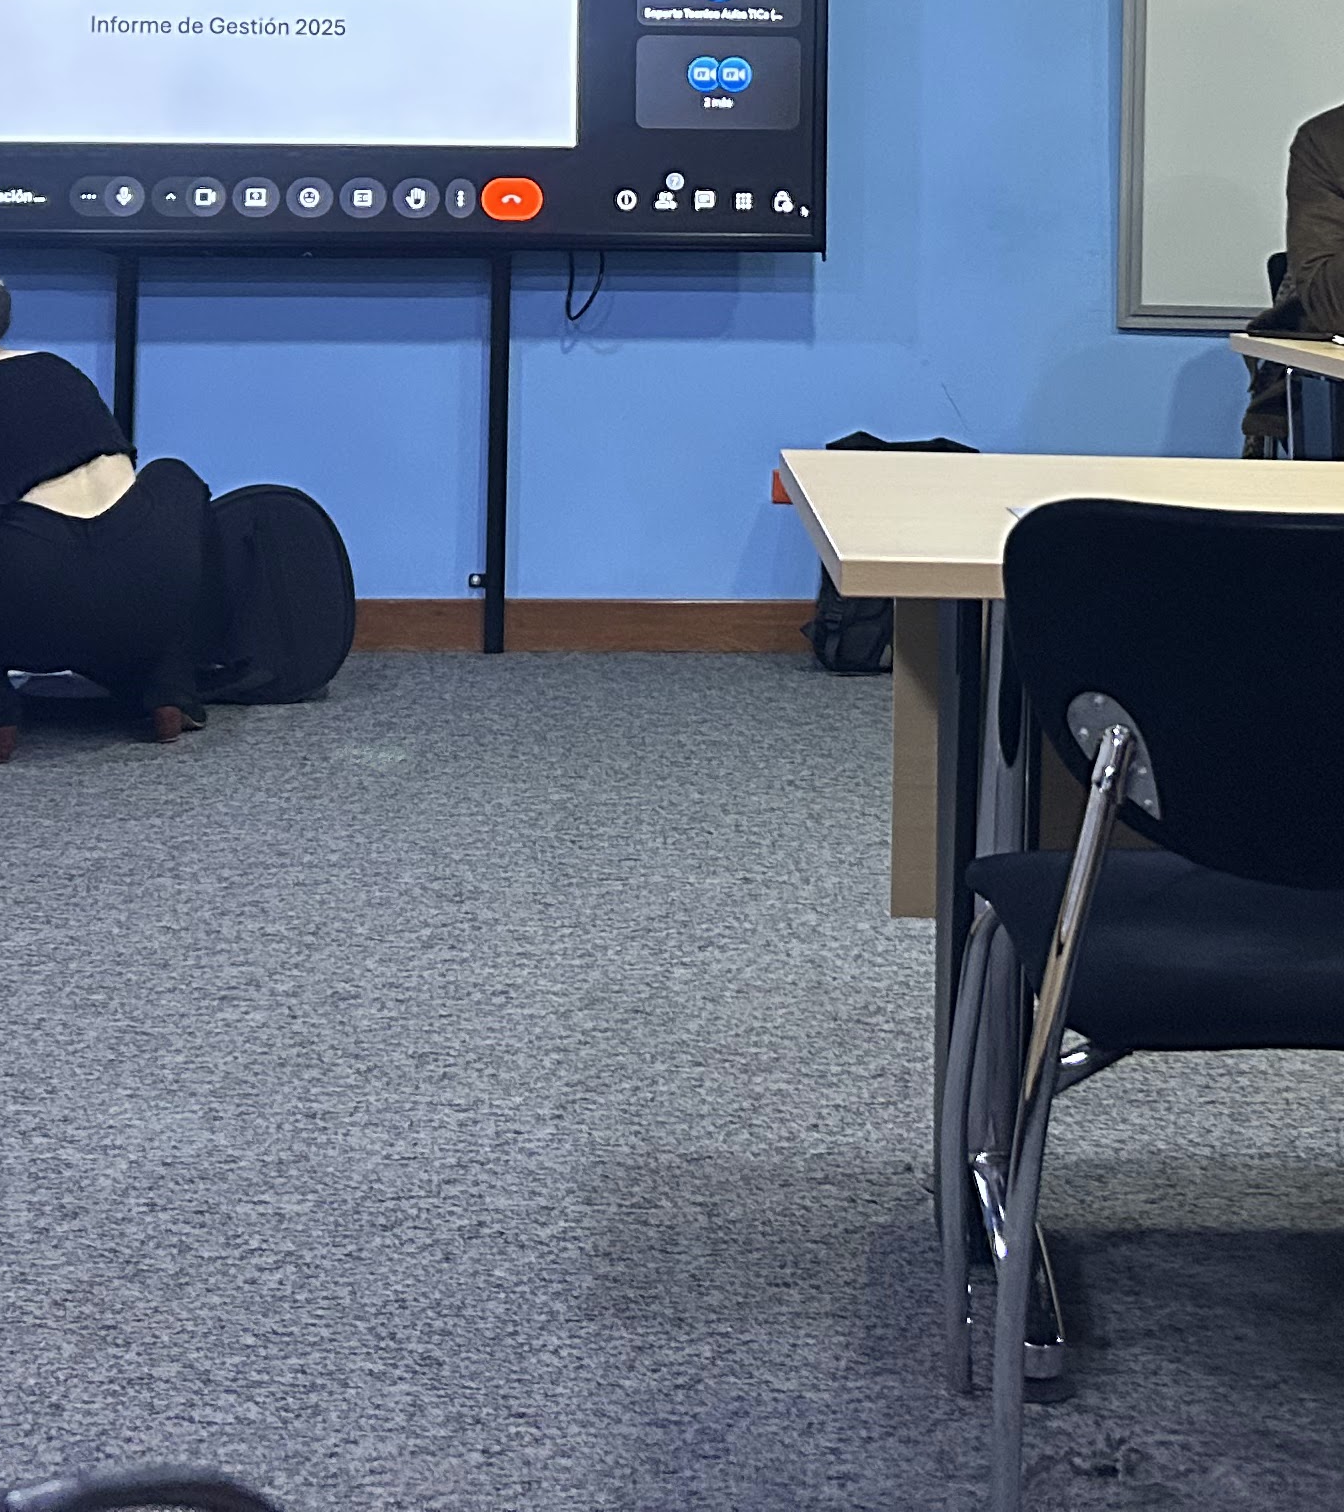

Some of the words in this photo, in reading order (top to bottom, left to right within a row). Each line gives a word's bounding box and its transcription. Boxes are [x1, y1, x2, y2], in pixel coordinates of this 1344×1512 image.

[91, 15, 172, 34] Informe
[178, 17, 204, 34] de
[209, 17, 290, 36] Gestión
[295, 18, 346, 36] 2025
